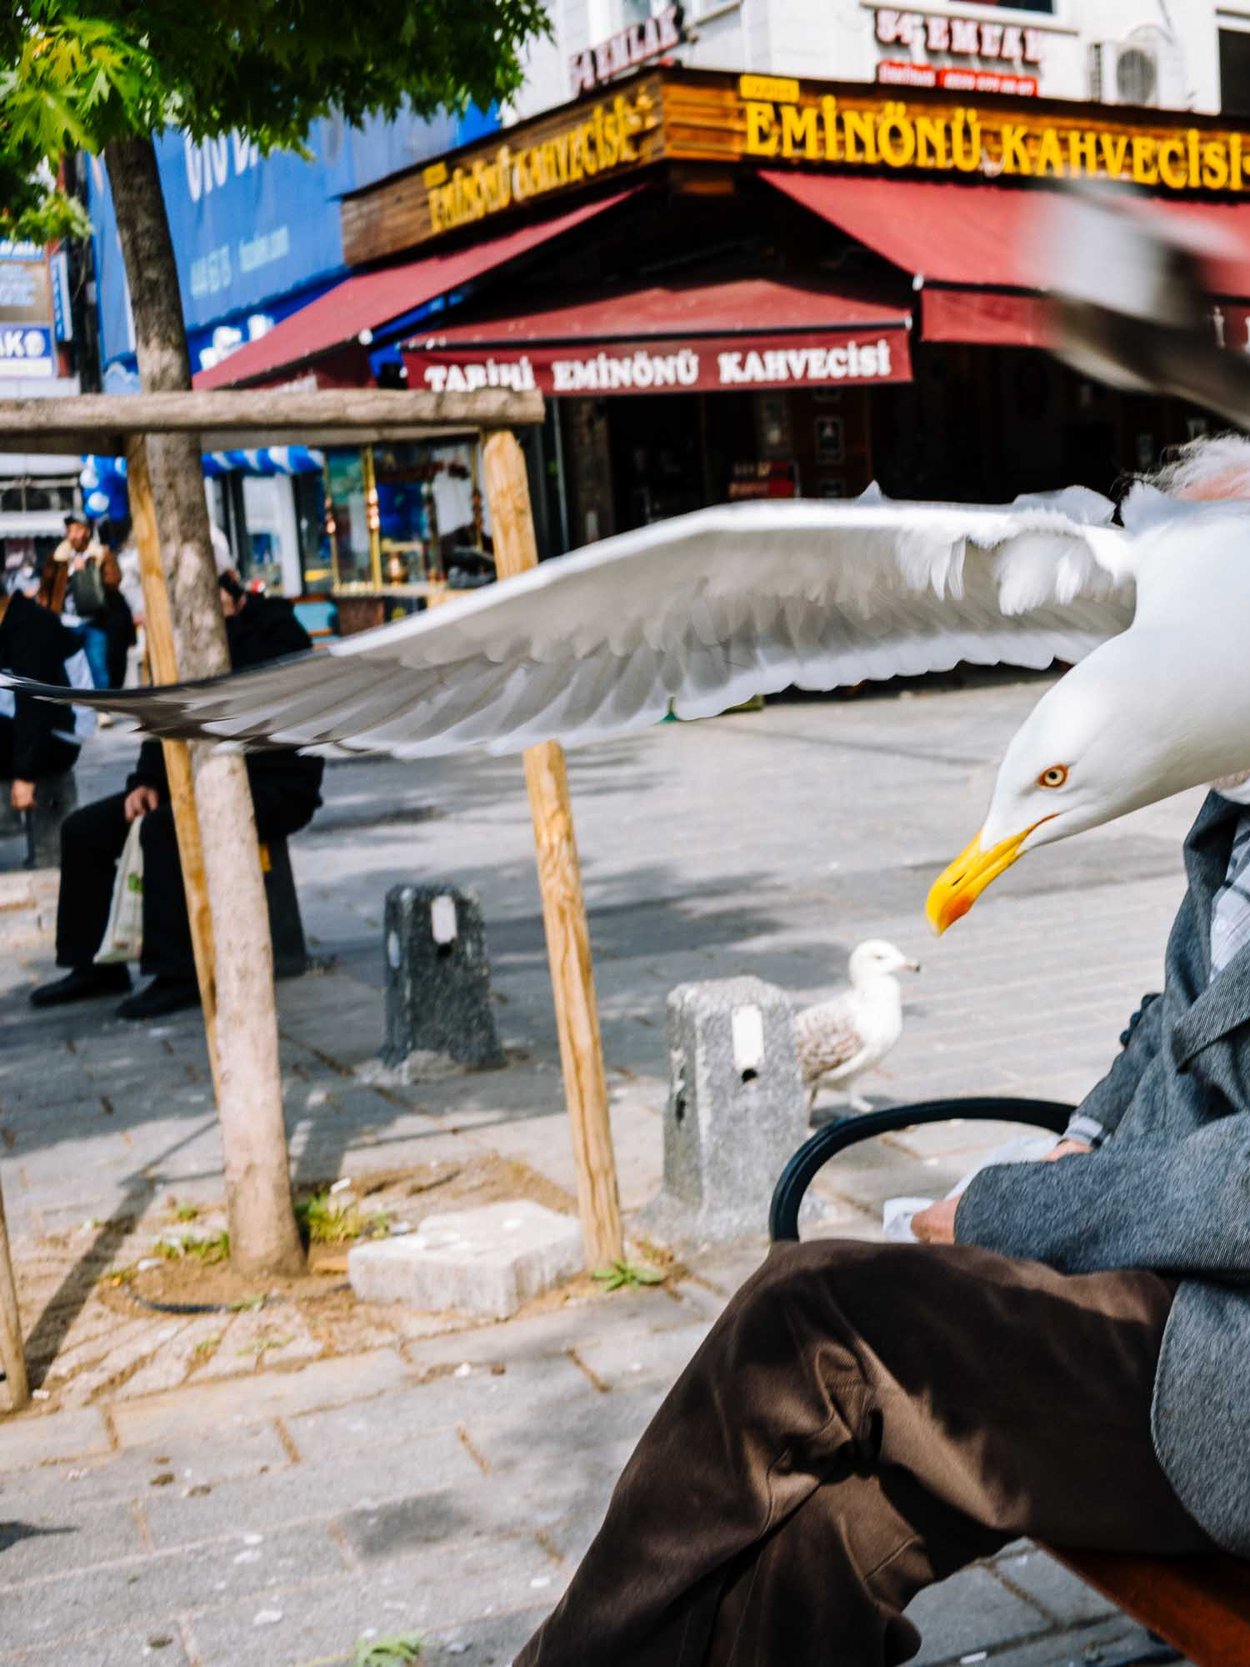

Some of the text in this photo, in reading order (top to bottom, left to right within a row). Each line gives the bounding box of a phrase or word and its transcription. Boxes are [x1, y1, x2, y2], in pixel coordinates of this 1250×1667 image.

[746, 95, 1243, 191] EMİNÖNÜ KAHVECİSİ
[0, 329, 46, 358] KO
[552, 348, 699, 391] EMİNÖNÜ
[717, 338, 892, 384] KAHVECİSİ
